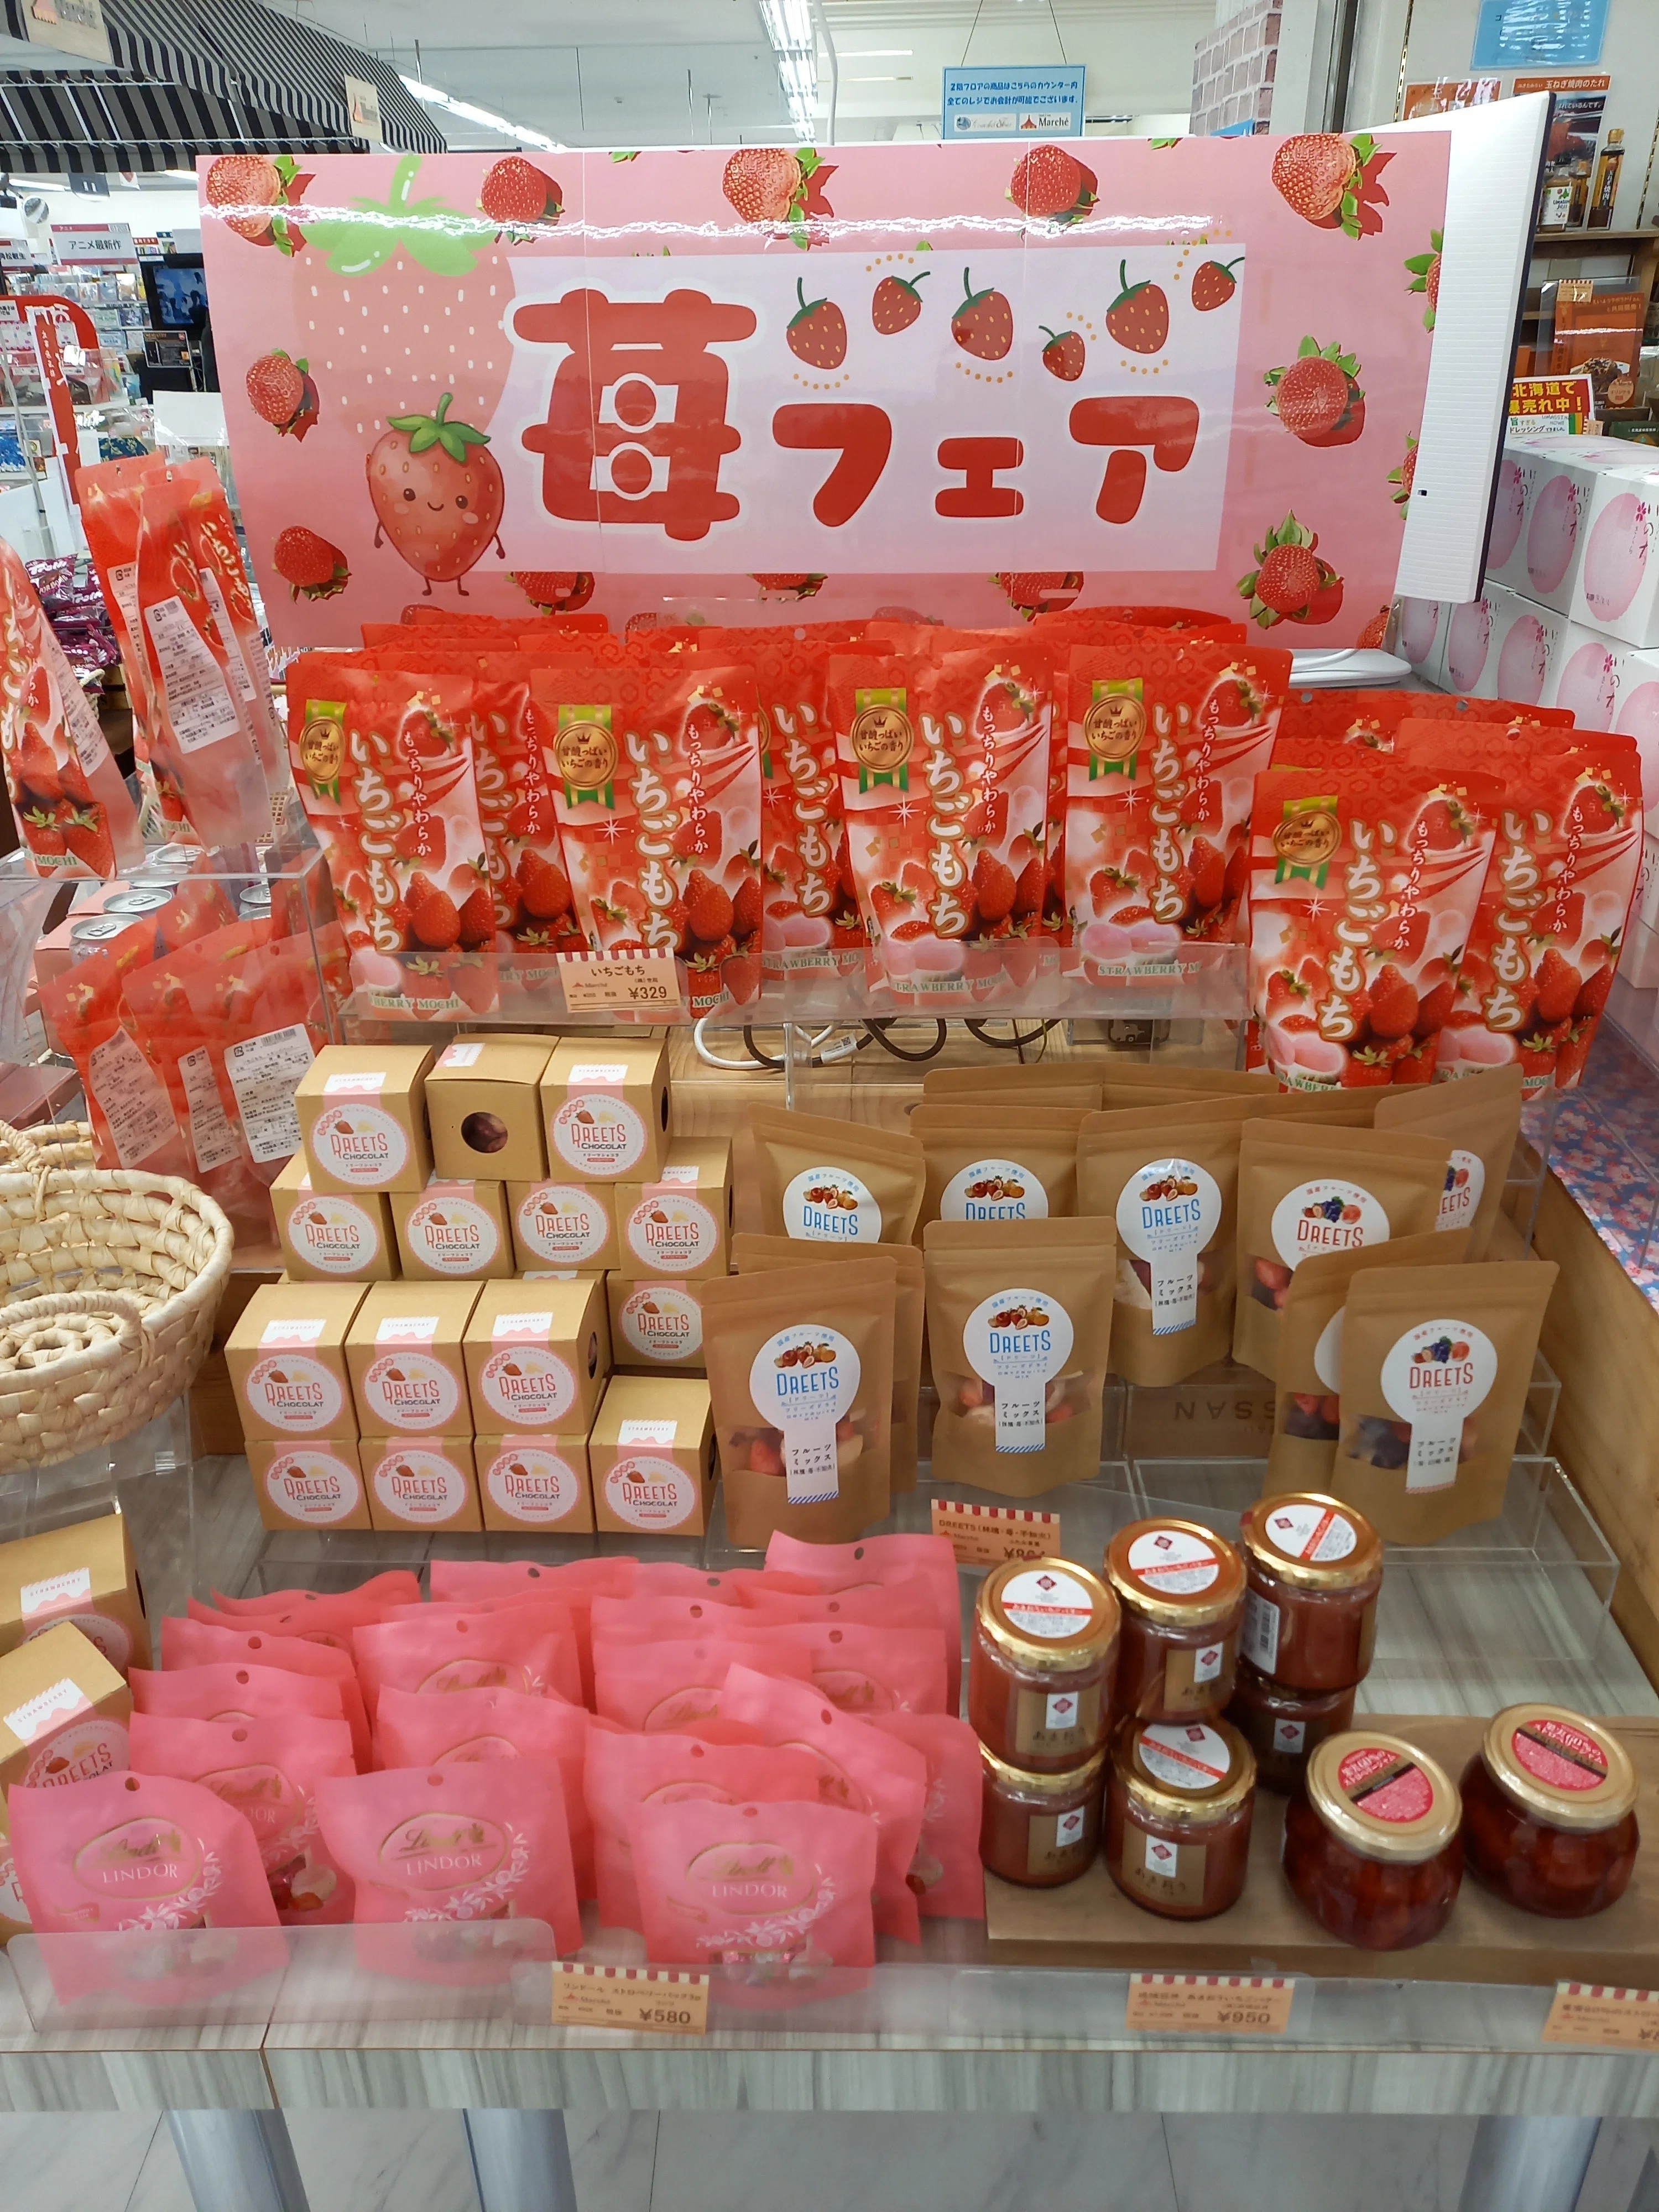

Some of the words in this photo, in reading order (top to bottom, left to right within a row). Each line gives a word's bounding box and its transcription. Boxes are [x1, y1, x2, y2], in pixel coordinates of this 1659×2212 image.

[1039, 116, 1069, 127] Marché
[68, 239, 122, 250] アニメ最新作
[1512, 380, 1577, 398] 北海道で
[512, 288, 1201, 541] 苺フェア
[524, 708, 541, 834] もっちりやわらか
[981, 706, 999, 834] もっちりやわらか
[1196, 699, 1220, 822] もっちりやわらか
[403, 731, 431, 857] もっちりやわらか
[687, 723, 708, 854] もっちりやわらか
[774, 705, 831, 914] いちごもち
[1152, 703, 1189, 921] いちごもち
[921, 713, 966, 935] いちごもち
[349, 731, 403, 952] いちごもち
[625, 731, 681, 950] いちごもち
[36, 855, 77, 867] MOCHI
[1552, 807, 1584, 932] もっちりやわらか
[1393, 820, 1428, 951] もっちりやわらか
[1319, 820, 1395, 1039] いちごもち
[1485, 811, 1549, 1029] いちごもち
[591, 965, 645, 977] いちごもち
[1098, 964, 1185, 976] STRAWBERRY
[419, 998, 460, 1009] MOCHI
[628, 986, 667, 1000] ¥329
[1141, 1198, 1201, 1229] DREETS
[1441, 1187, 1470, 1214] EETS
[804, 1205, 858, 1235] DREETS
[1297, 1219, 1364, 1248] DREETS
[1157, 1274, 1193, 1287] フルーツ
[1159, 1284, 1193, 1297] ミックス
[989, 1329, 1051, 1354] DREETS
[776, 1366, 839, 1396] DREETS
[1410, 1361, 1474, 1389] DREETS
[511, 1392, 557, 1401] CHOCOLAT
[1003, 1409, 1039, 1418] ミックス
[791, 1444, 832, 1456] フルーツ
[794, 1453, 831, 1465] ミックス
[102, 1863, 179, 1884] LINDOR
[406, 1853, 483, 1876] LINDOR
[712, 1882, 788, 1899] LINDOR
[639, 2007, 691, 2024] ¥580
[1217, 2010, 1271, 2024] ¥950
